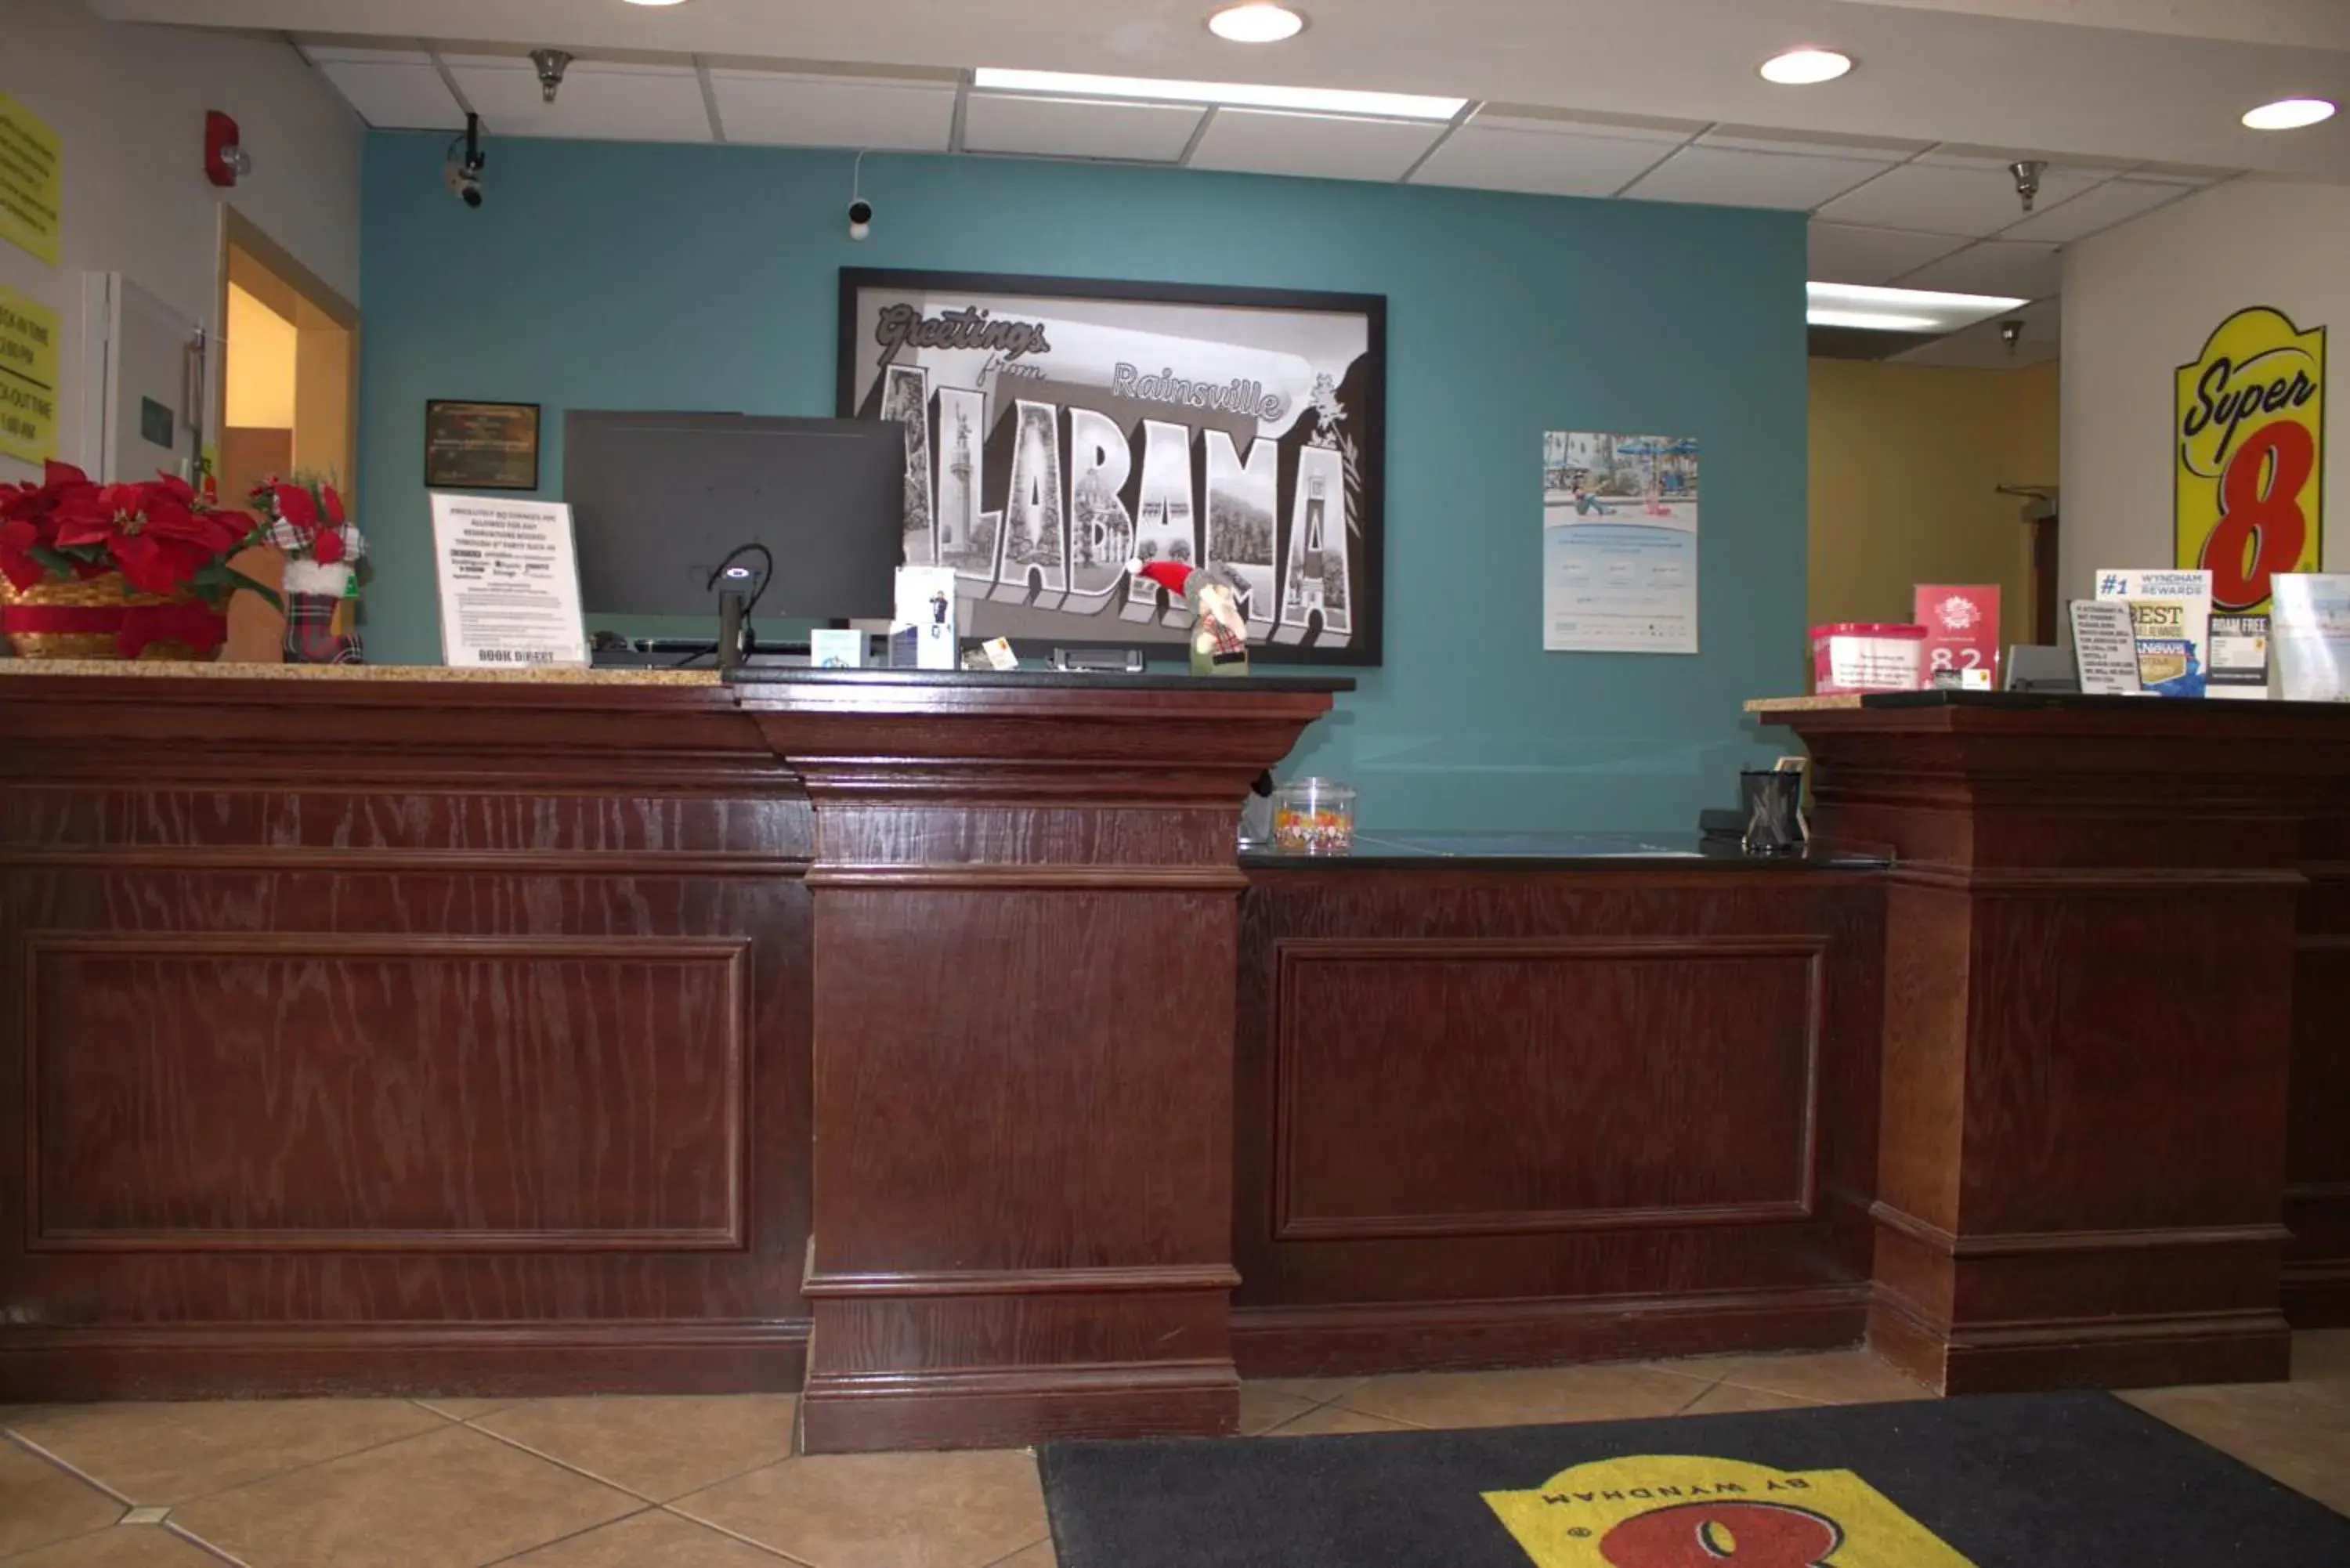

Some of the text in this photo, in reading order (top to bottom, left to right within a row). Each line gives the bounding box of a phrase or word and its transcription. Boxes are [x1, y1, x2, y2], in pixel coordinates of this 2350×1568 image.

[875, 303, 1051, 369] Greetings
[976, 353, 1047, 387] from
[1112, 362, 1283, 424] Rainsville
[2183, 356, 2317, 464] Super
[2197, 418, 2314, 612] 8
[2101, 573, 2203, 594] #1 WYNDHAM
[2141, 585, 2202, 595] REWARDS
[479, 649, 512, 662] BOOK
[1541, 1477, 1810, 1505] BY WYNDHAM
